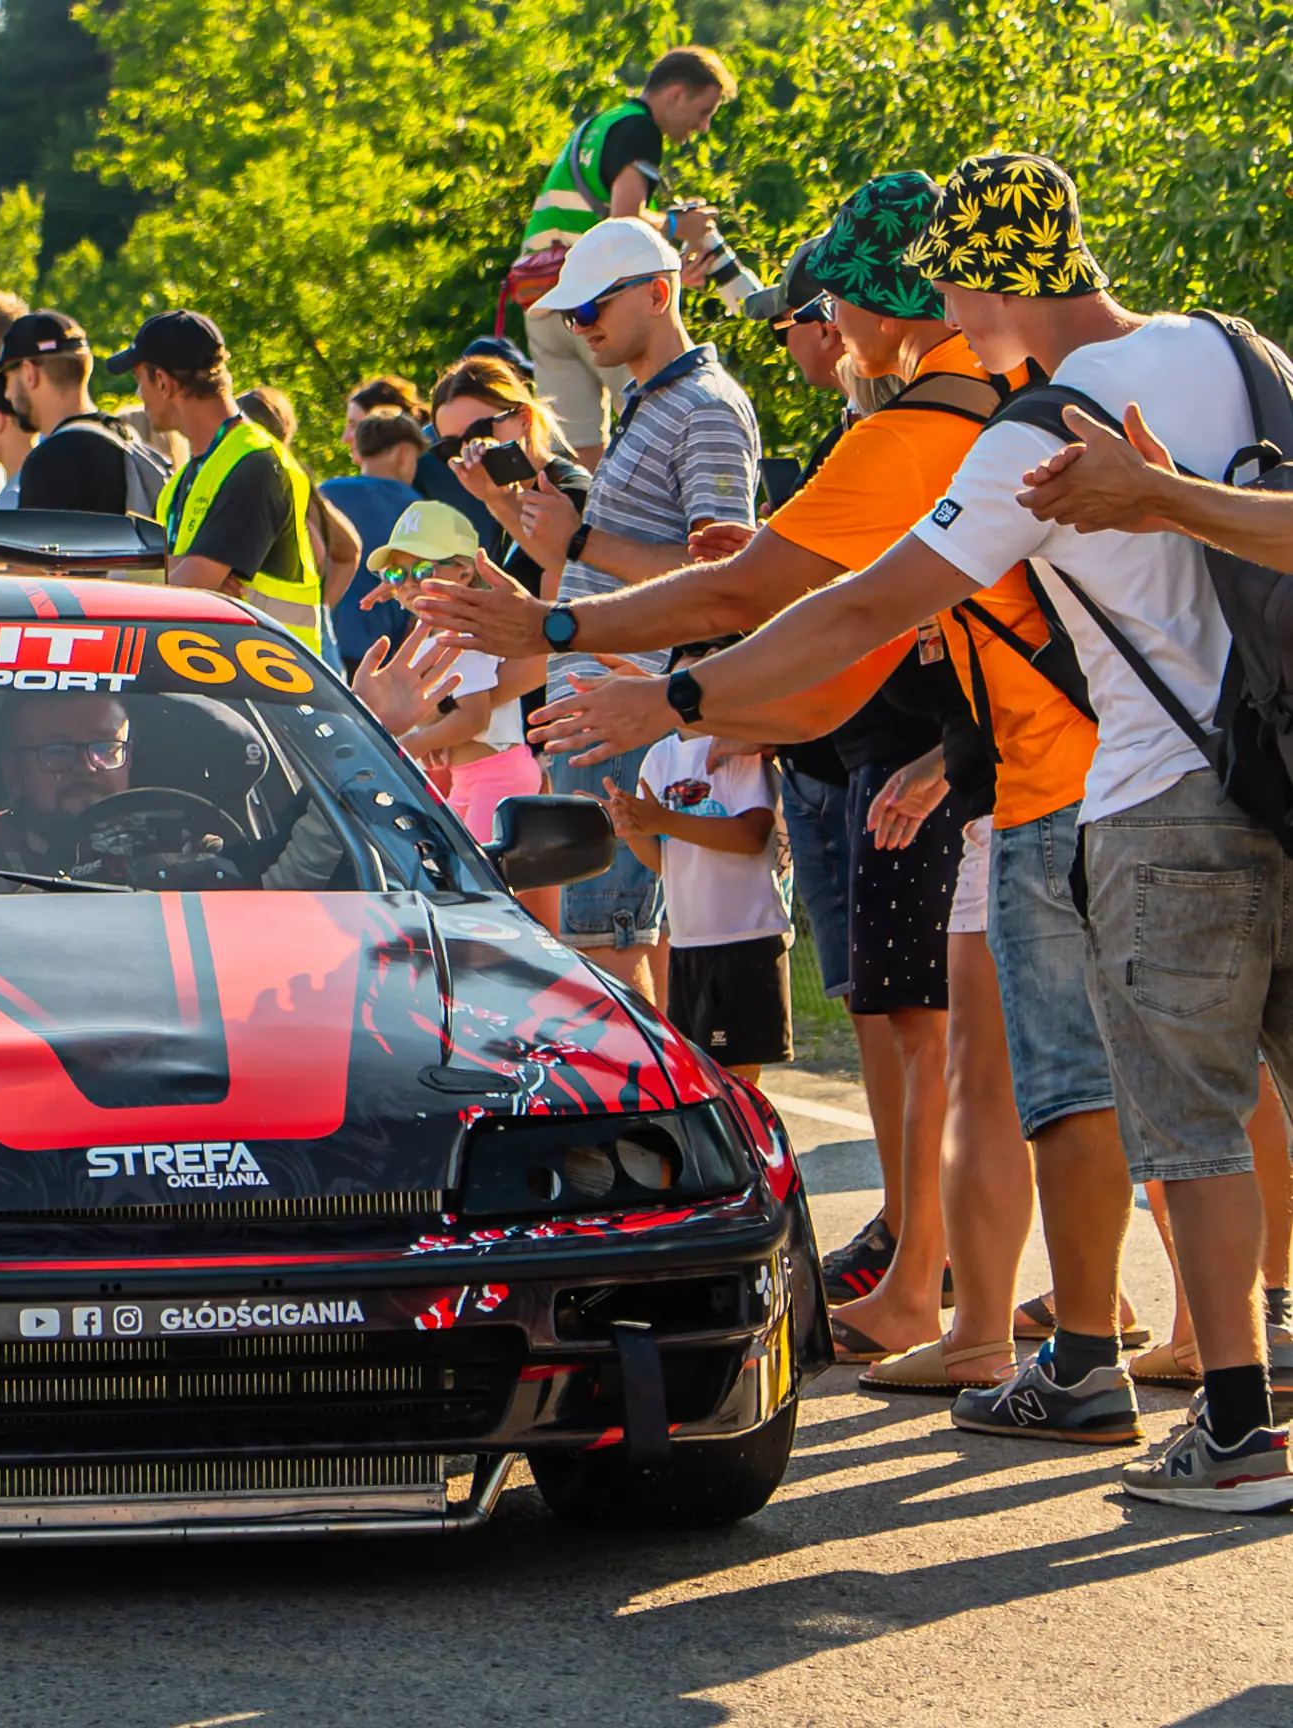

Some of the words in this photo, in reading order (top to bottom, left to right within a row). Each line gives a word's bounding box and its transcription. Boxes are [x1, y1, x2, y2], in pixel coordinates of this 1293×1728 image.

[156, 629, 314, 693] 66
[86, 1142, 261, 1178] STREFA
[166, 1171, 270, 1190] OKLEJANIA
[160, 1300, 365, 1331] GŁÓDŚCIGANIA
